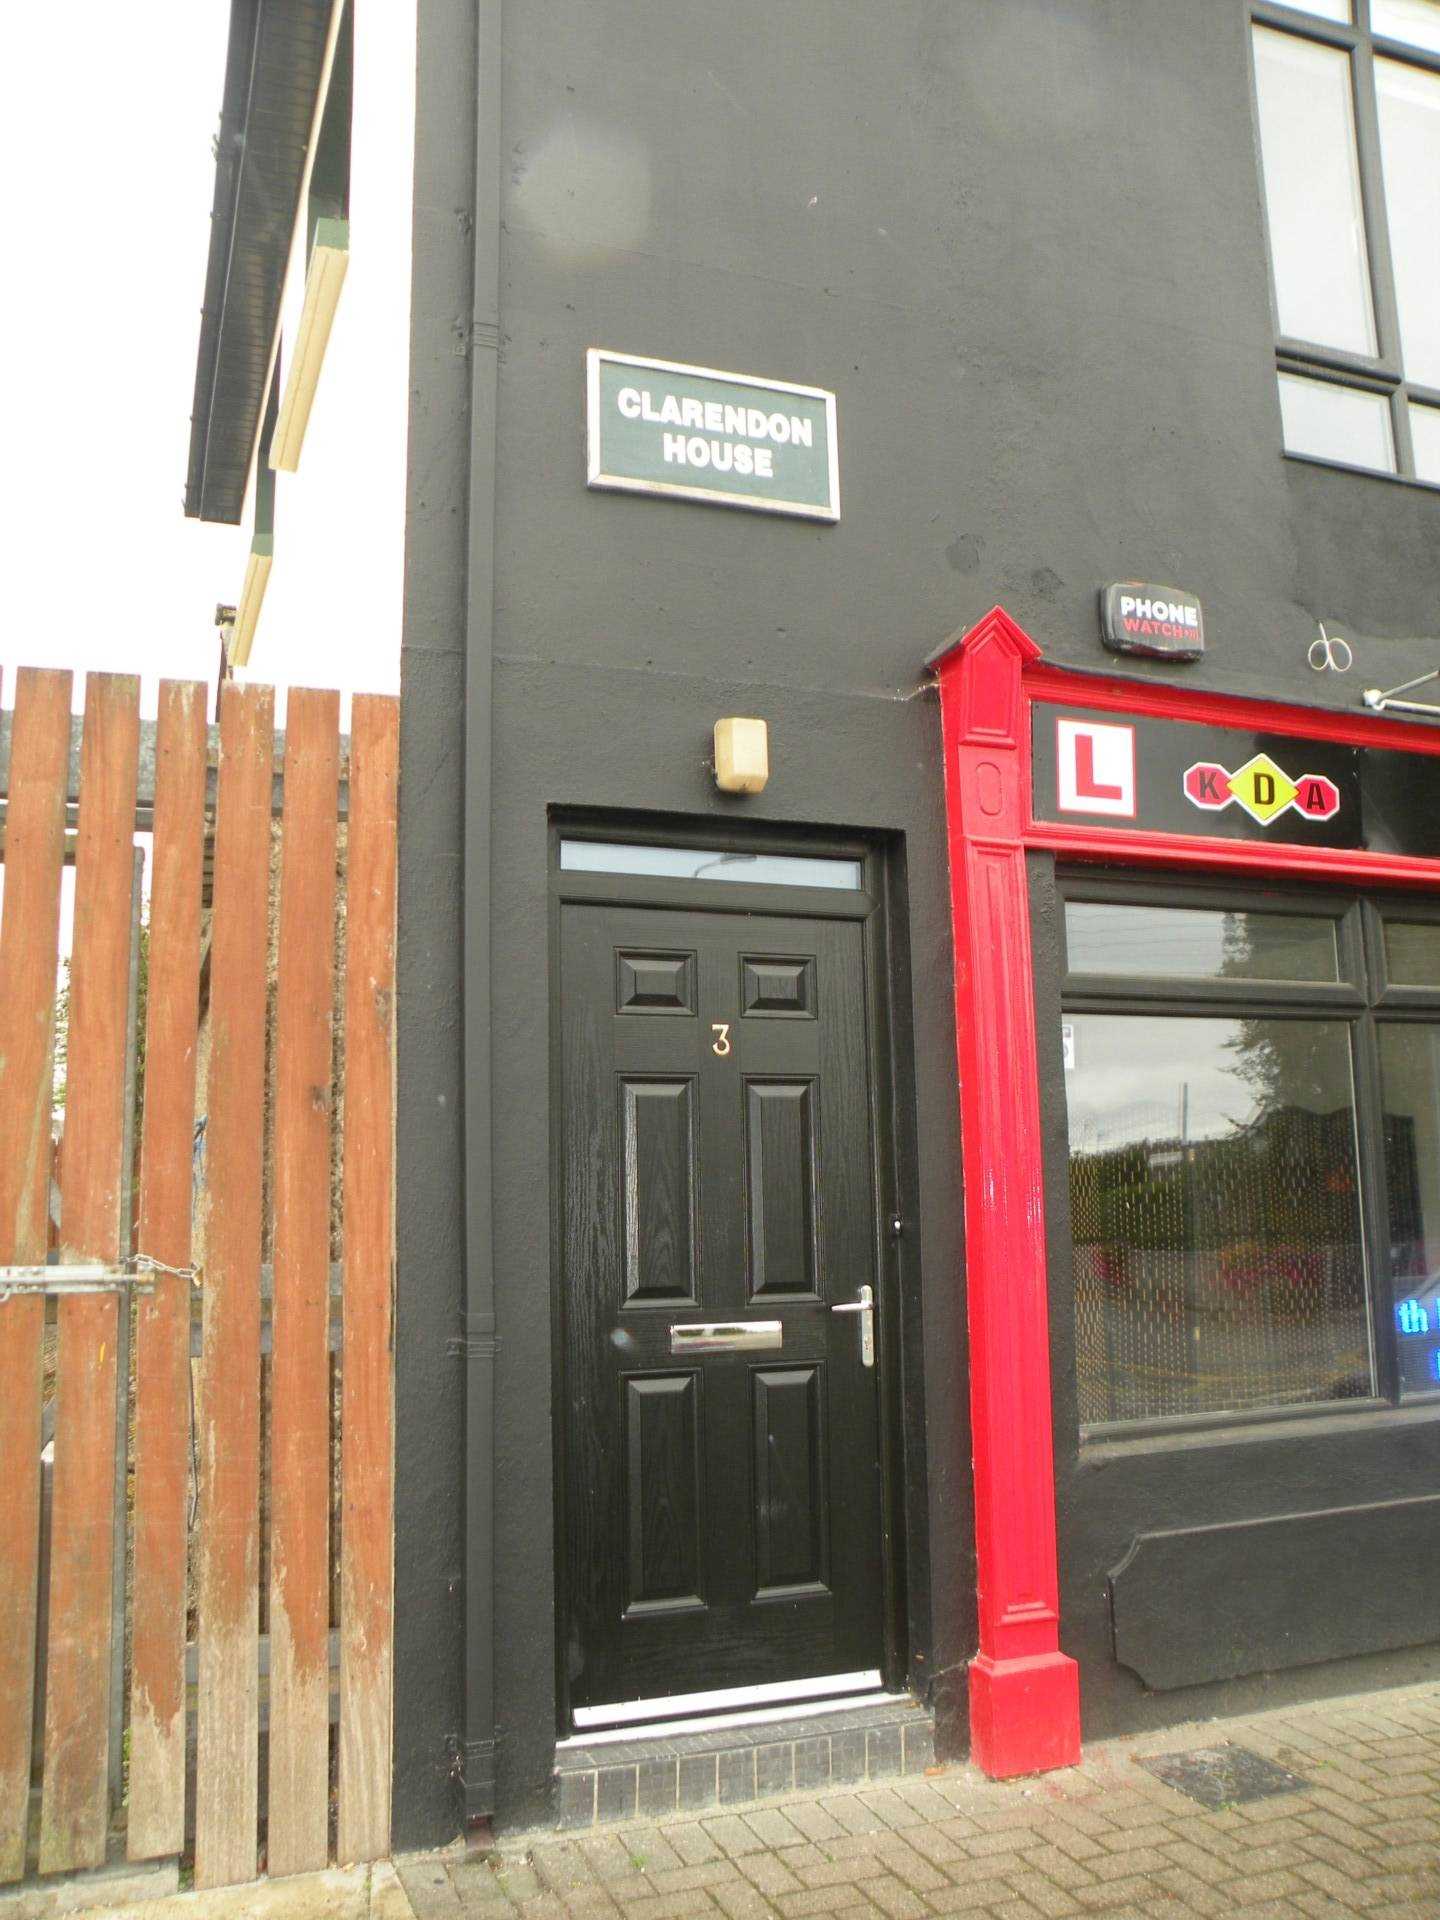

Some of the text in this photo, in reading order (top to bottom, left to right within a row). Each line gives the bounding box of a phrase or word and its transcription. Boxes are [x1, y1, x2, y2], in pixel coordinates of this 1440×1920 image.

[617, 387, 813, 447] CLARENDON
[663, 432, 774, 478] HOUSE
[1120, 595, 1199, 627] PHONE
[1123, 617, 1184, 640] WATCH
[1074, 733, 1123, 800] L
[711, 1023, 730, 1056] 3
